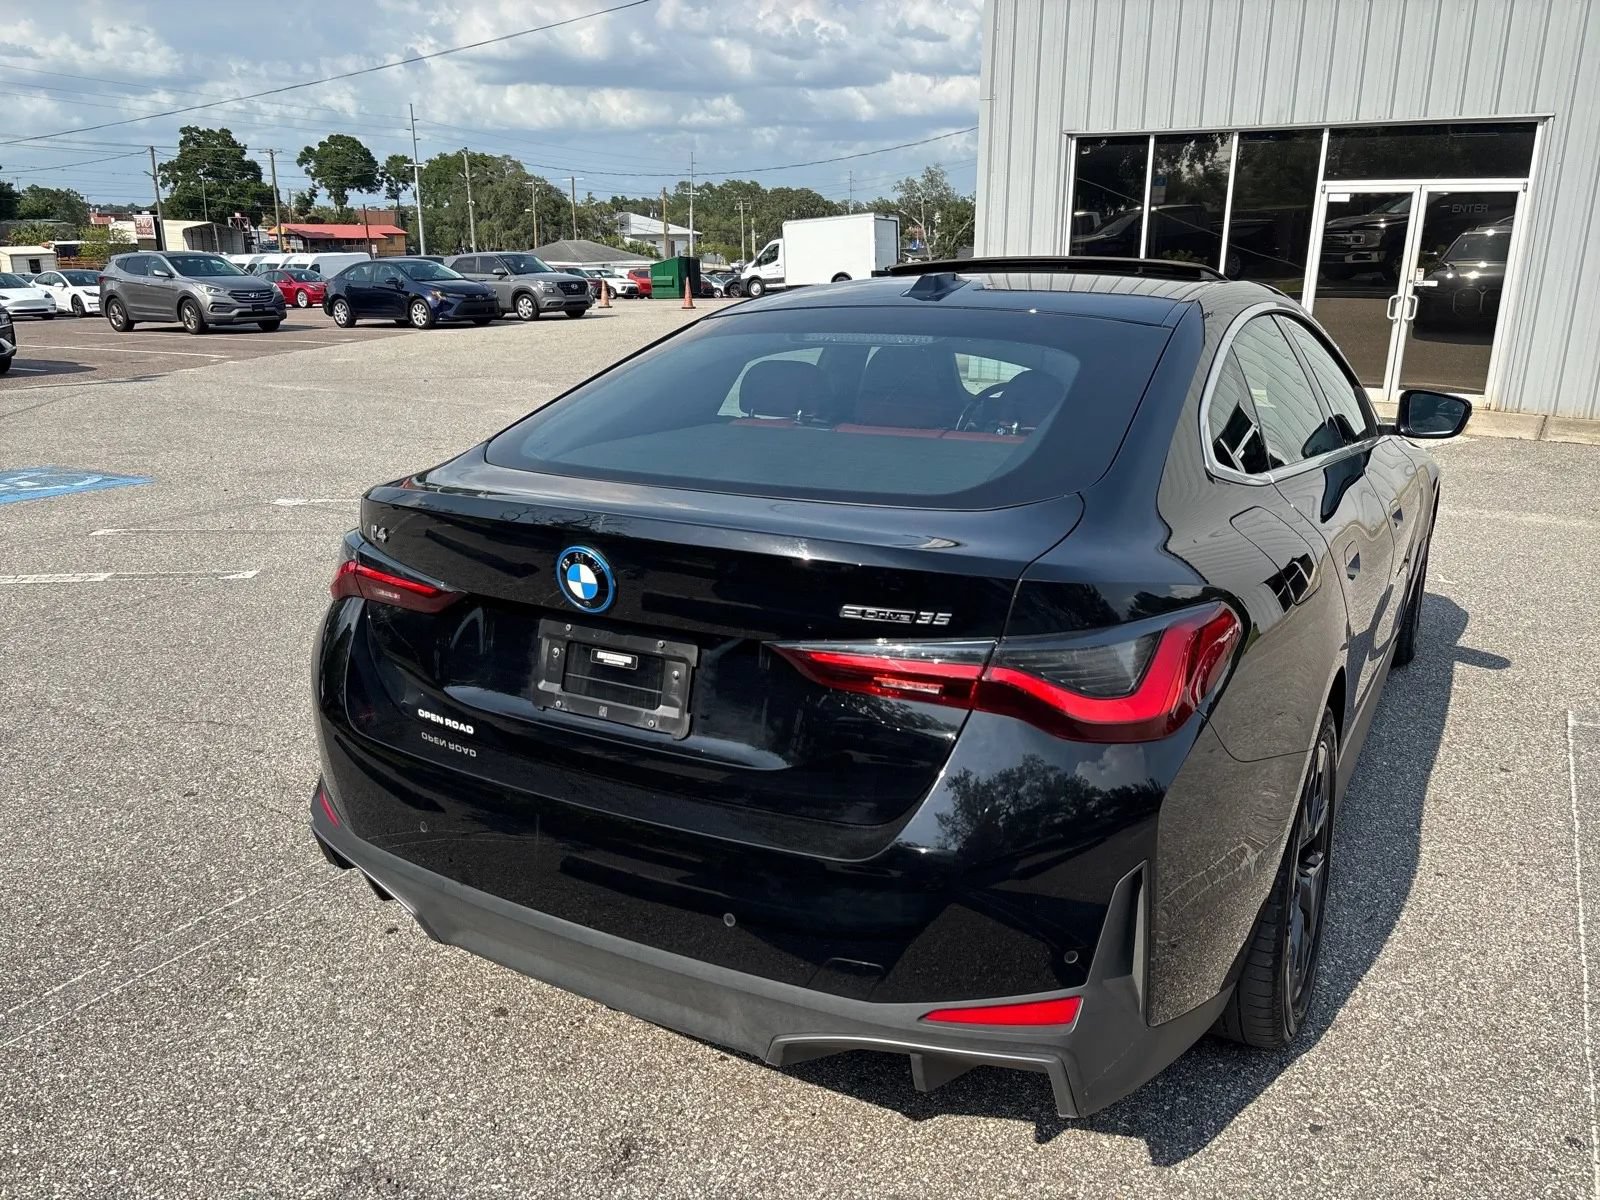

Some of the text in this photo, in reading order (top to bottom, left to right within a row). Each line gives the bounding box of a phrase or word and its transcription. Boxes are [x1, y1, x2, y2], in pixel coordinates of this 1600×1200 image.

[1452, 204, 1488, 213] ENTER
[135, 217, 152, 228] EVO
[916, 611, 952, 625] 35
[418, 708, 474, 735] OPEN ROAD
